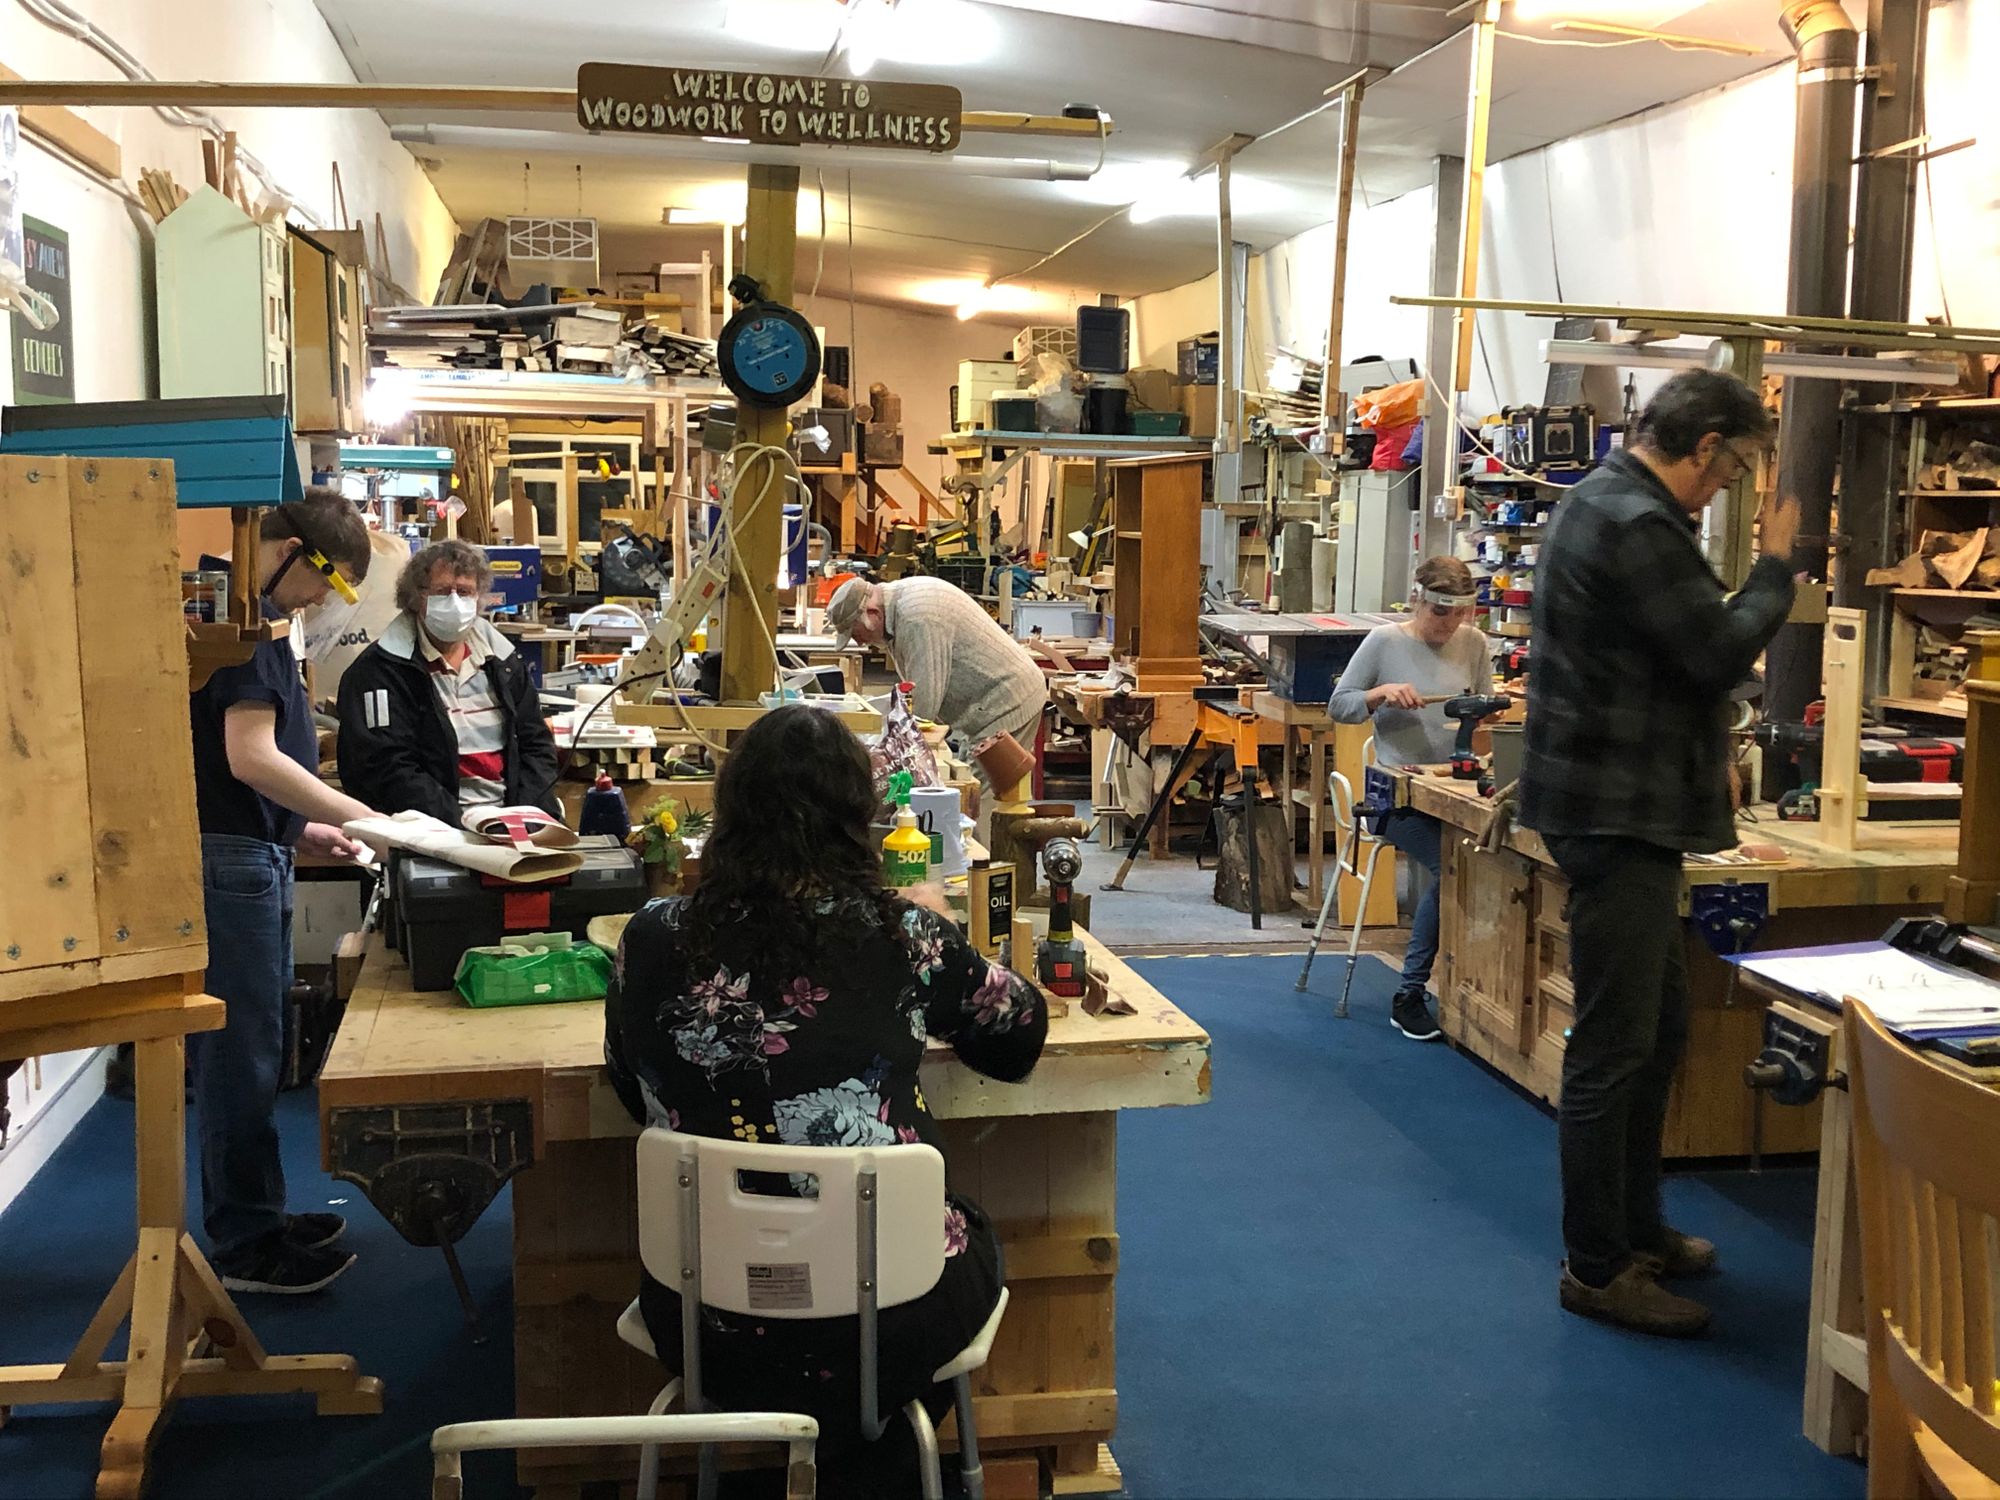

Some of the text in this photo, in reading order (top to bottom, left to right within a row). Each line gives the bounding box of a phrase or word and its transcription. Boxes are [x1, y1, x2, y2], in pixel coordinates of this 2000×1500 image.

[673, 70, 870, 108] WELCOME TO
[581, 97, 951, 144] WOODWORK TO WELLNESS
[897, 850, 926, 864] 502
[990, 896, 1010, 908] OIL
